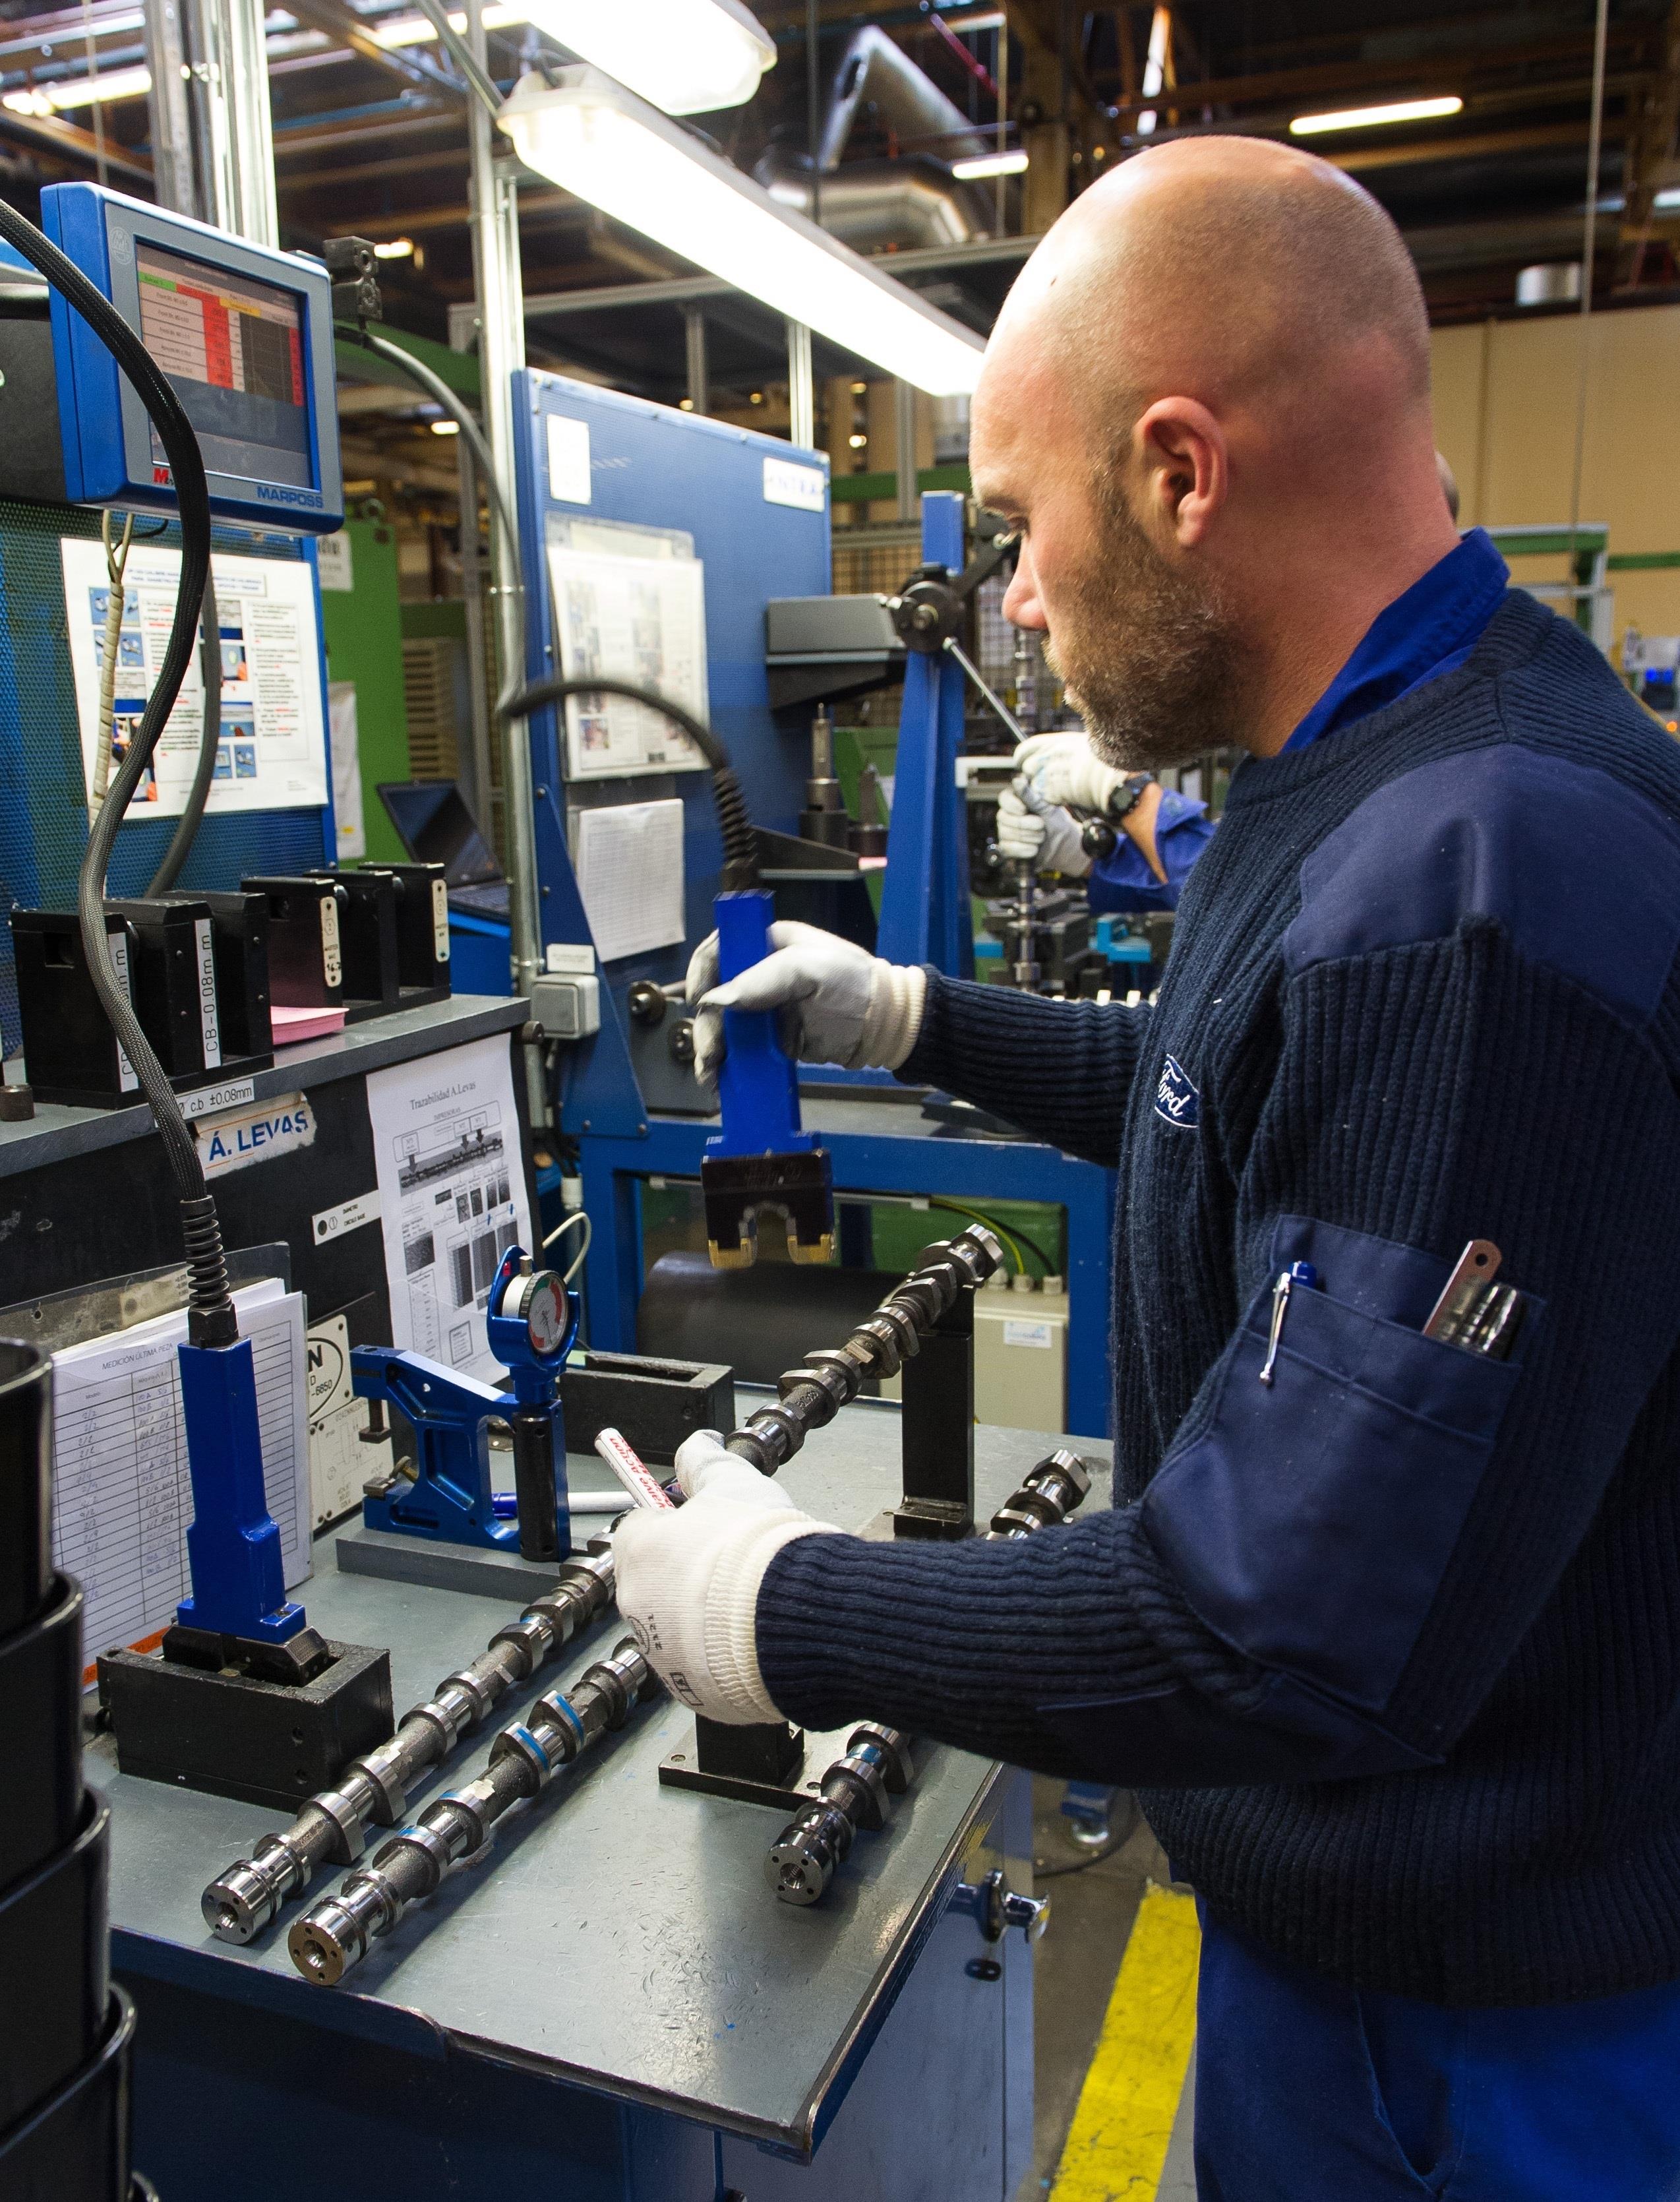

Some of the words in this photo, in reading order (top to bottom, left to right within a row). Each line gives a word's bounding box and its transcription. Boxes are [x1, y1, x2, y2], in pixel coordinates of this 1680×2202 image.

[256, 485, 323, 508] MARPOSS
[210, 1087, 253, 1106] ±0.08mm
[1158, 1060, 1191, 1116] Ford
[237, 1110, 309, 1152] LEVAS
[102, 1355, 135, 1370] MEDICIÓN
